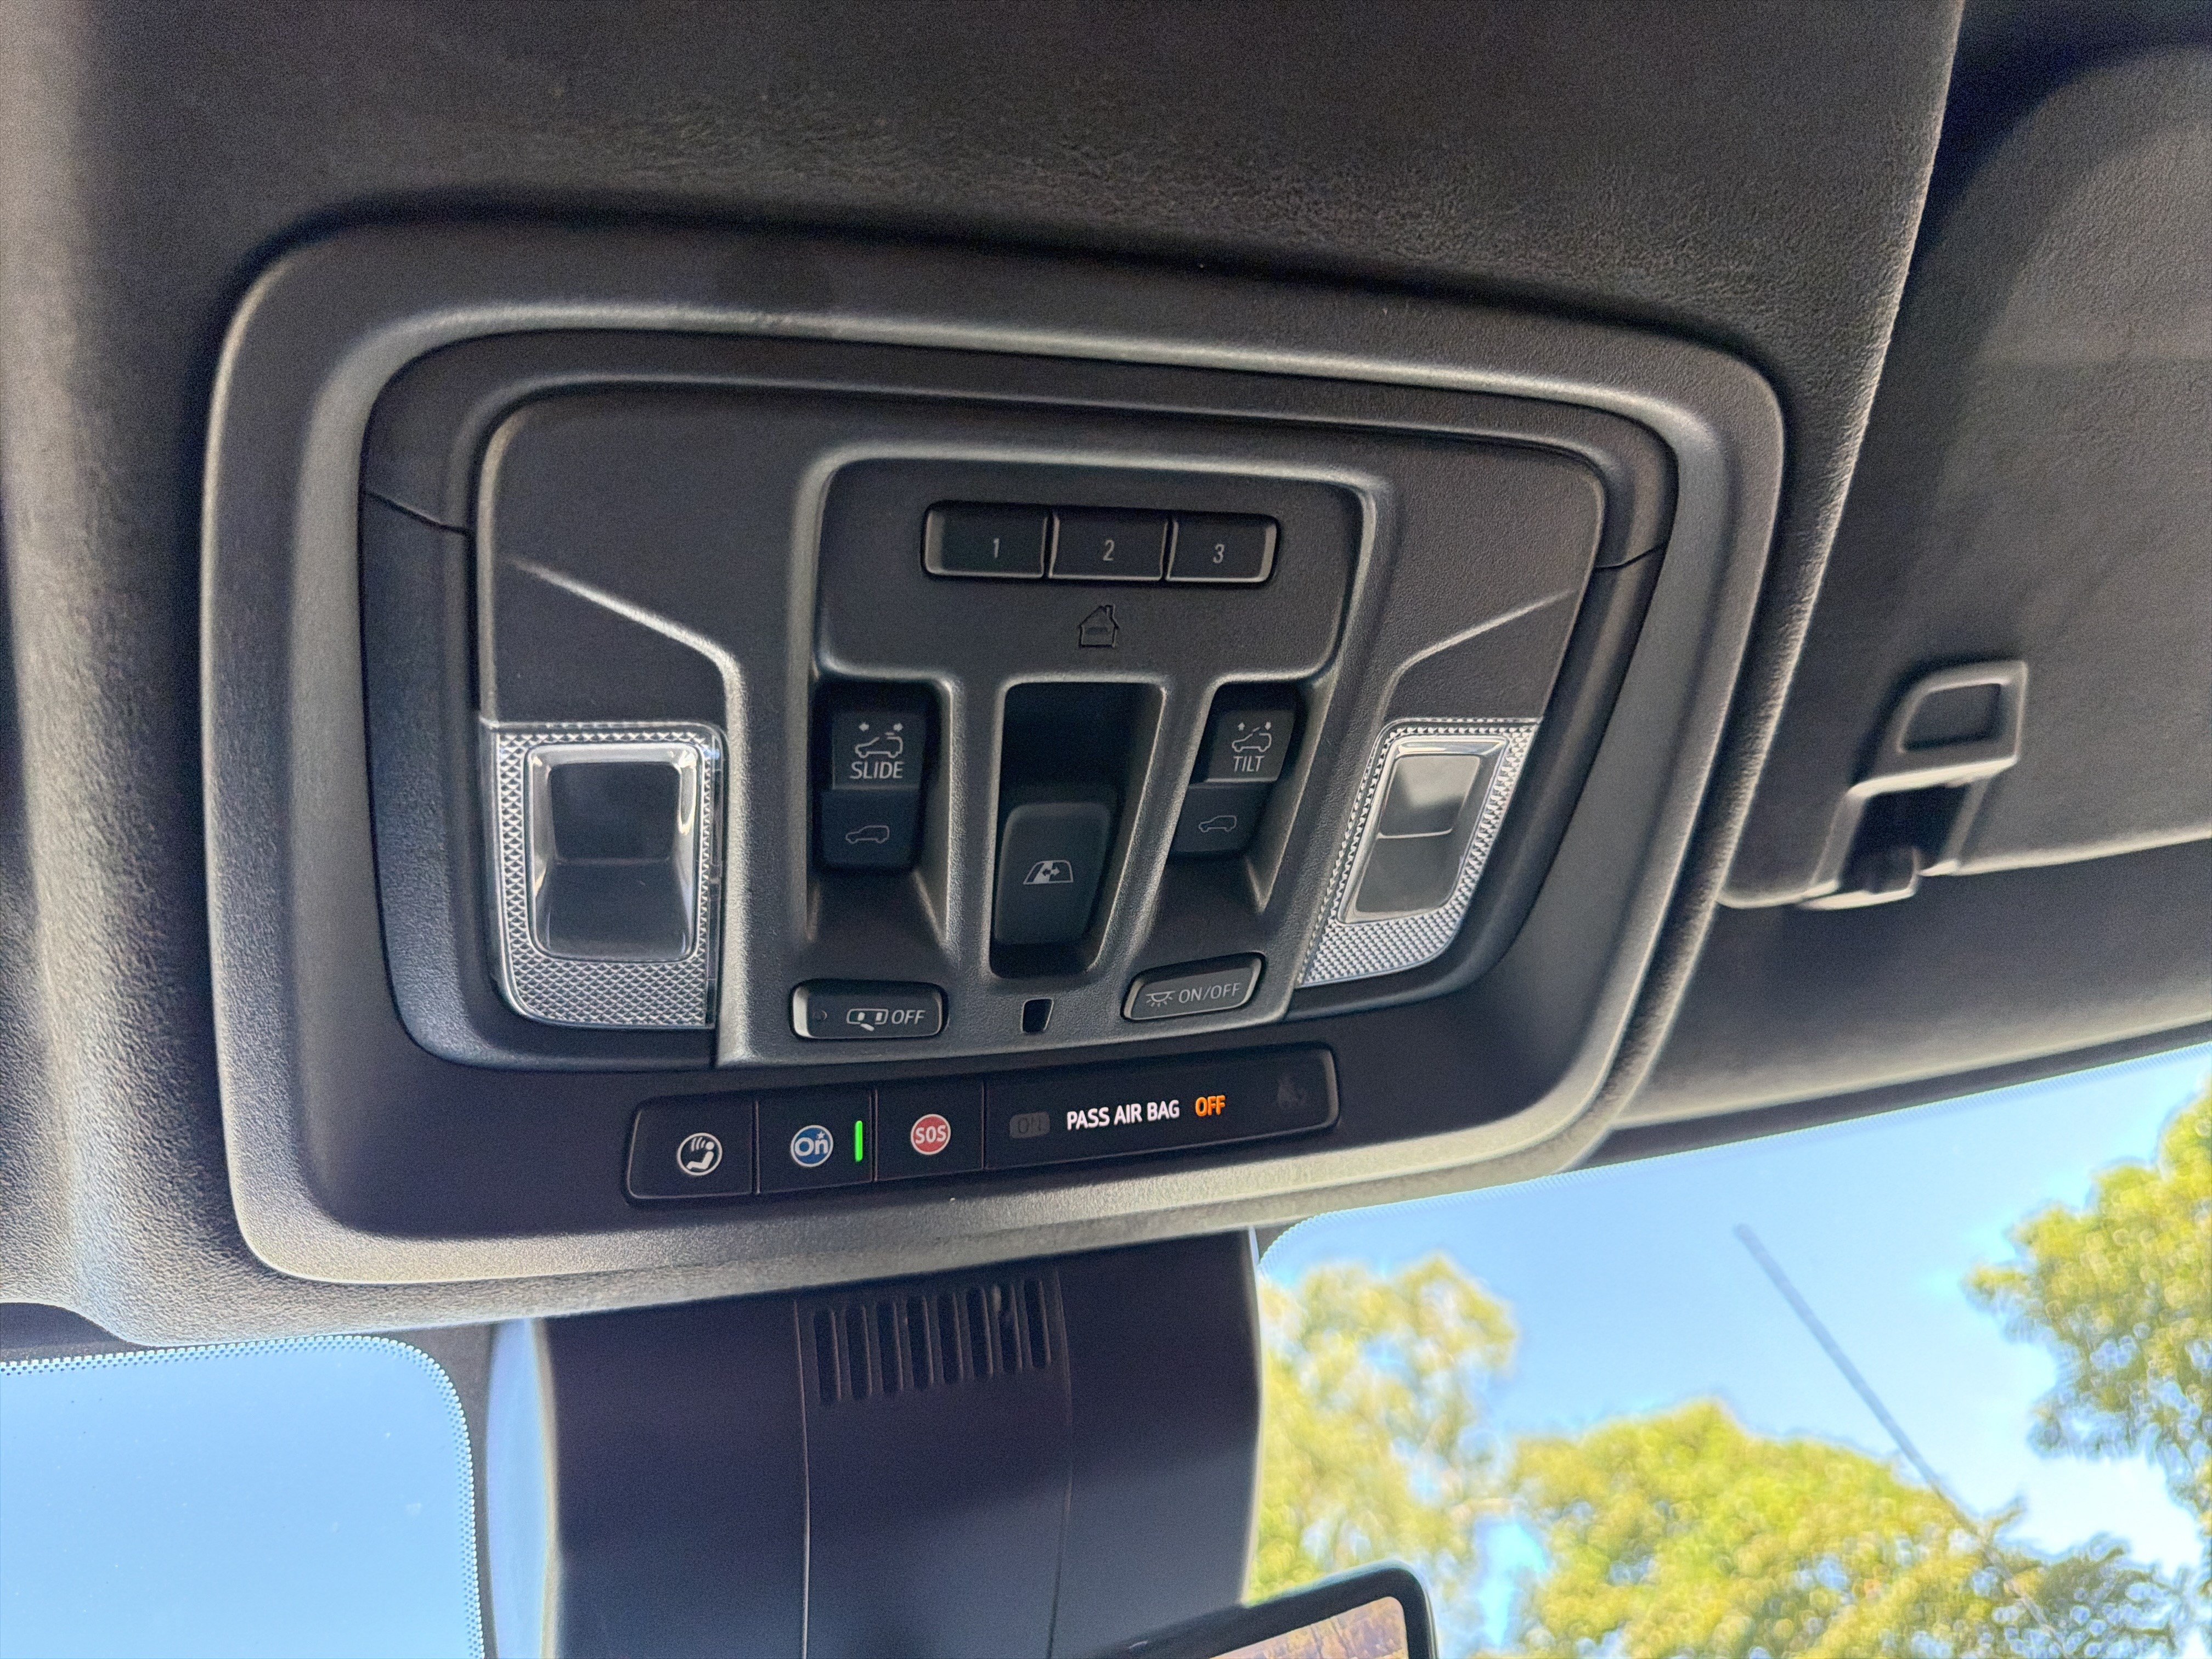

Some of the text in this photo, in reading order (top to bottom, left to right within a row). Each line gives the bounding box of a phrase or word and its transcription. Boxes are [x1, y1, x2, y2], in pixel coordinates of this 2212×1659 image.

[992, 538, 1000, 558] 1
[1102, 540, 1114, 561] 2
[1212, 544, 1224, 563] 3
[850, 761, 904, 779] SLIDE
[1233, 755, 1265, 772] TILT
[1178, 983, 1240, 1003] ON/OFF
[891, 1009, 926, 1024] OFF
[1067, 1095, 1226, 1130] PASS AIR BAG OFF
[915, 1125, 947, 1144] SOS
[794, 1135, 829, 1156] On
